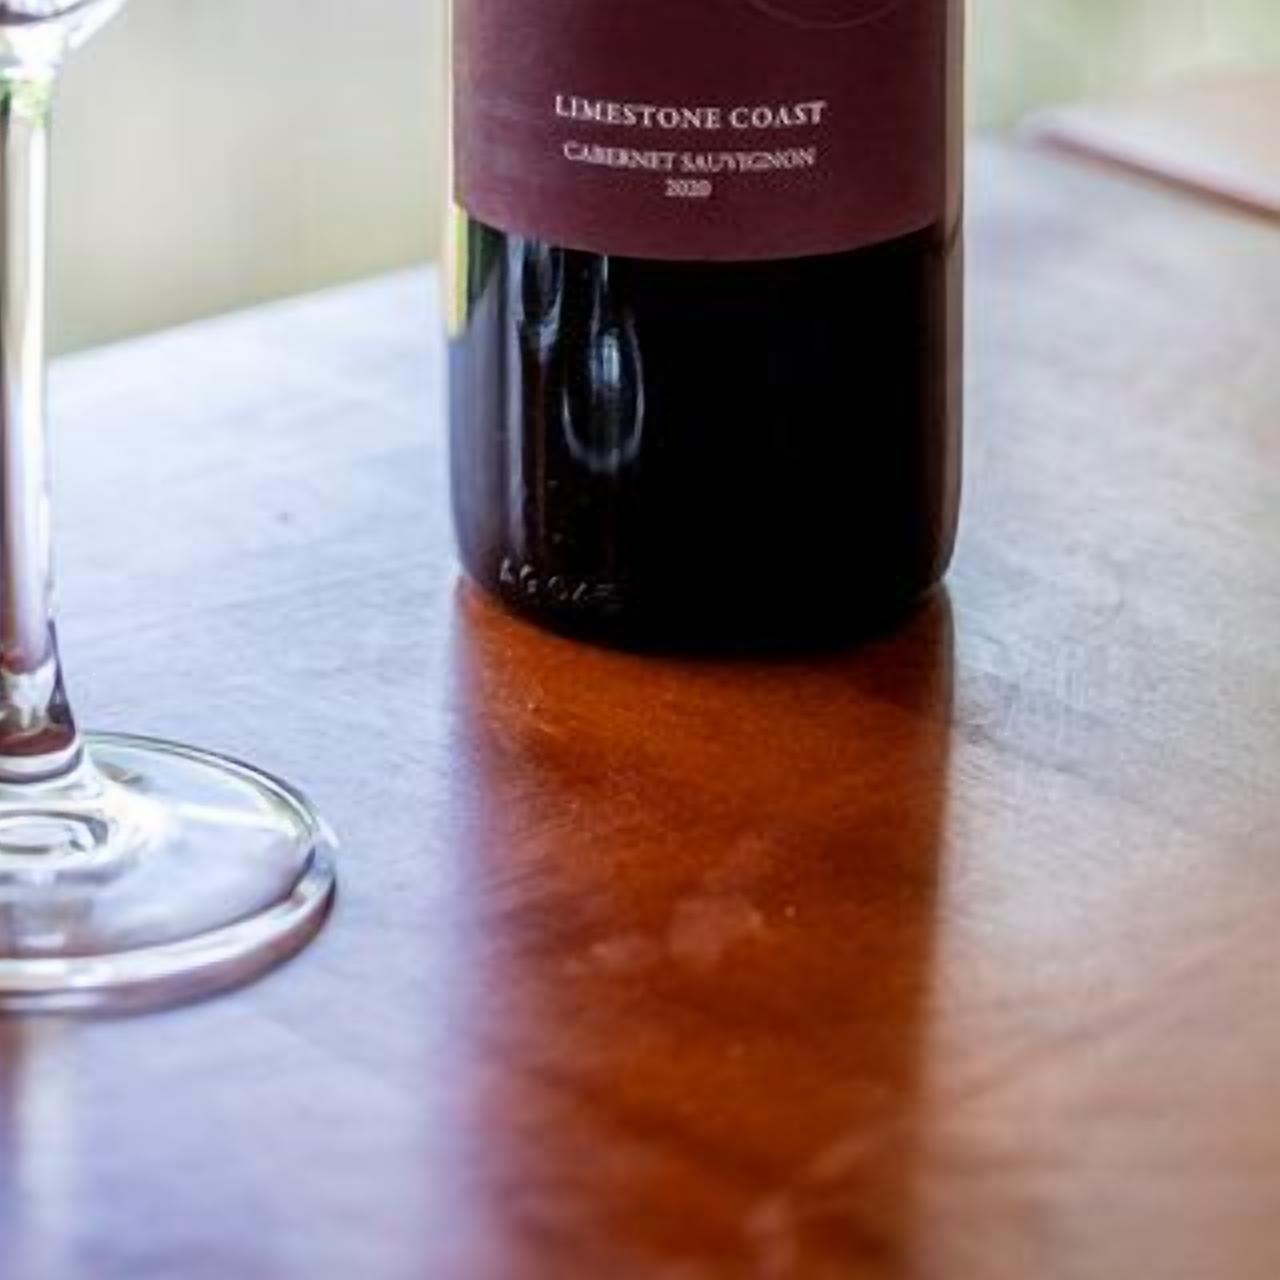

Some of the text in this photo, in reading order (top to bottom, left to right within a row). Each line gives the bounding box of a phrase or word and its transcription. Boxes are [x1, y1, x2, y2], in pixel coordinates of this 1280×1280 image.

[555, 94, 827, 128] LIMESTONE COAST
[562, 141, 816, 173] CABERNET SAUVIGNON
